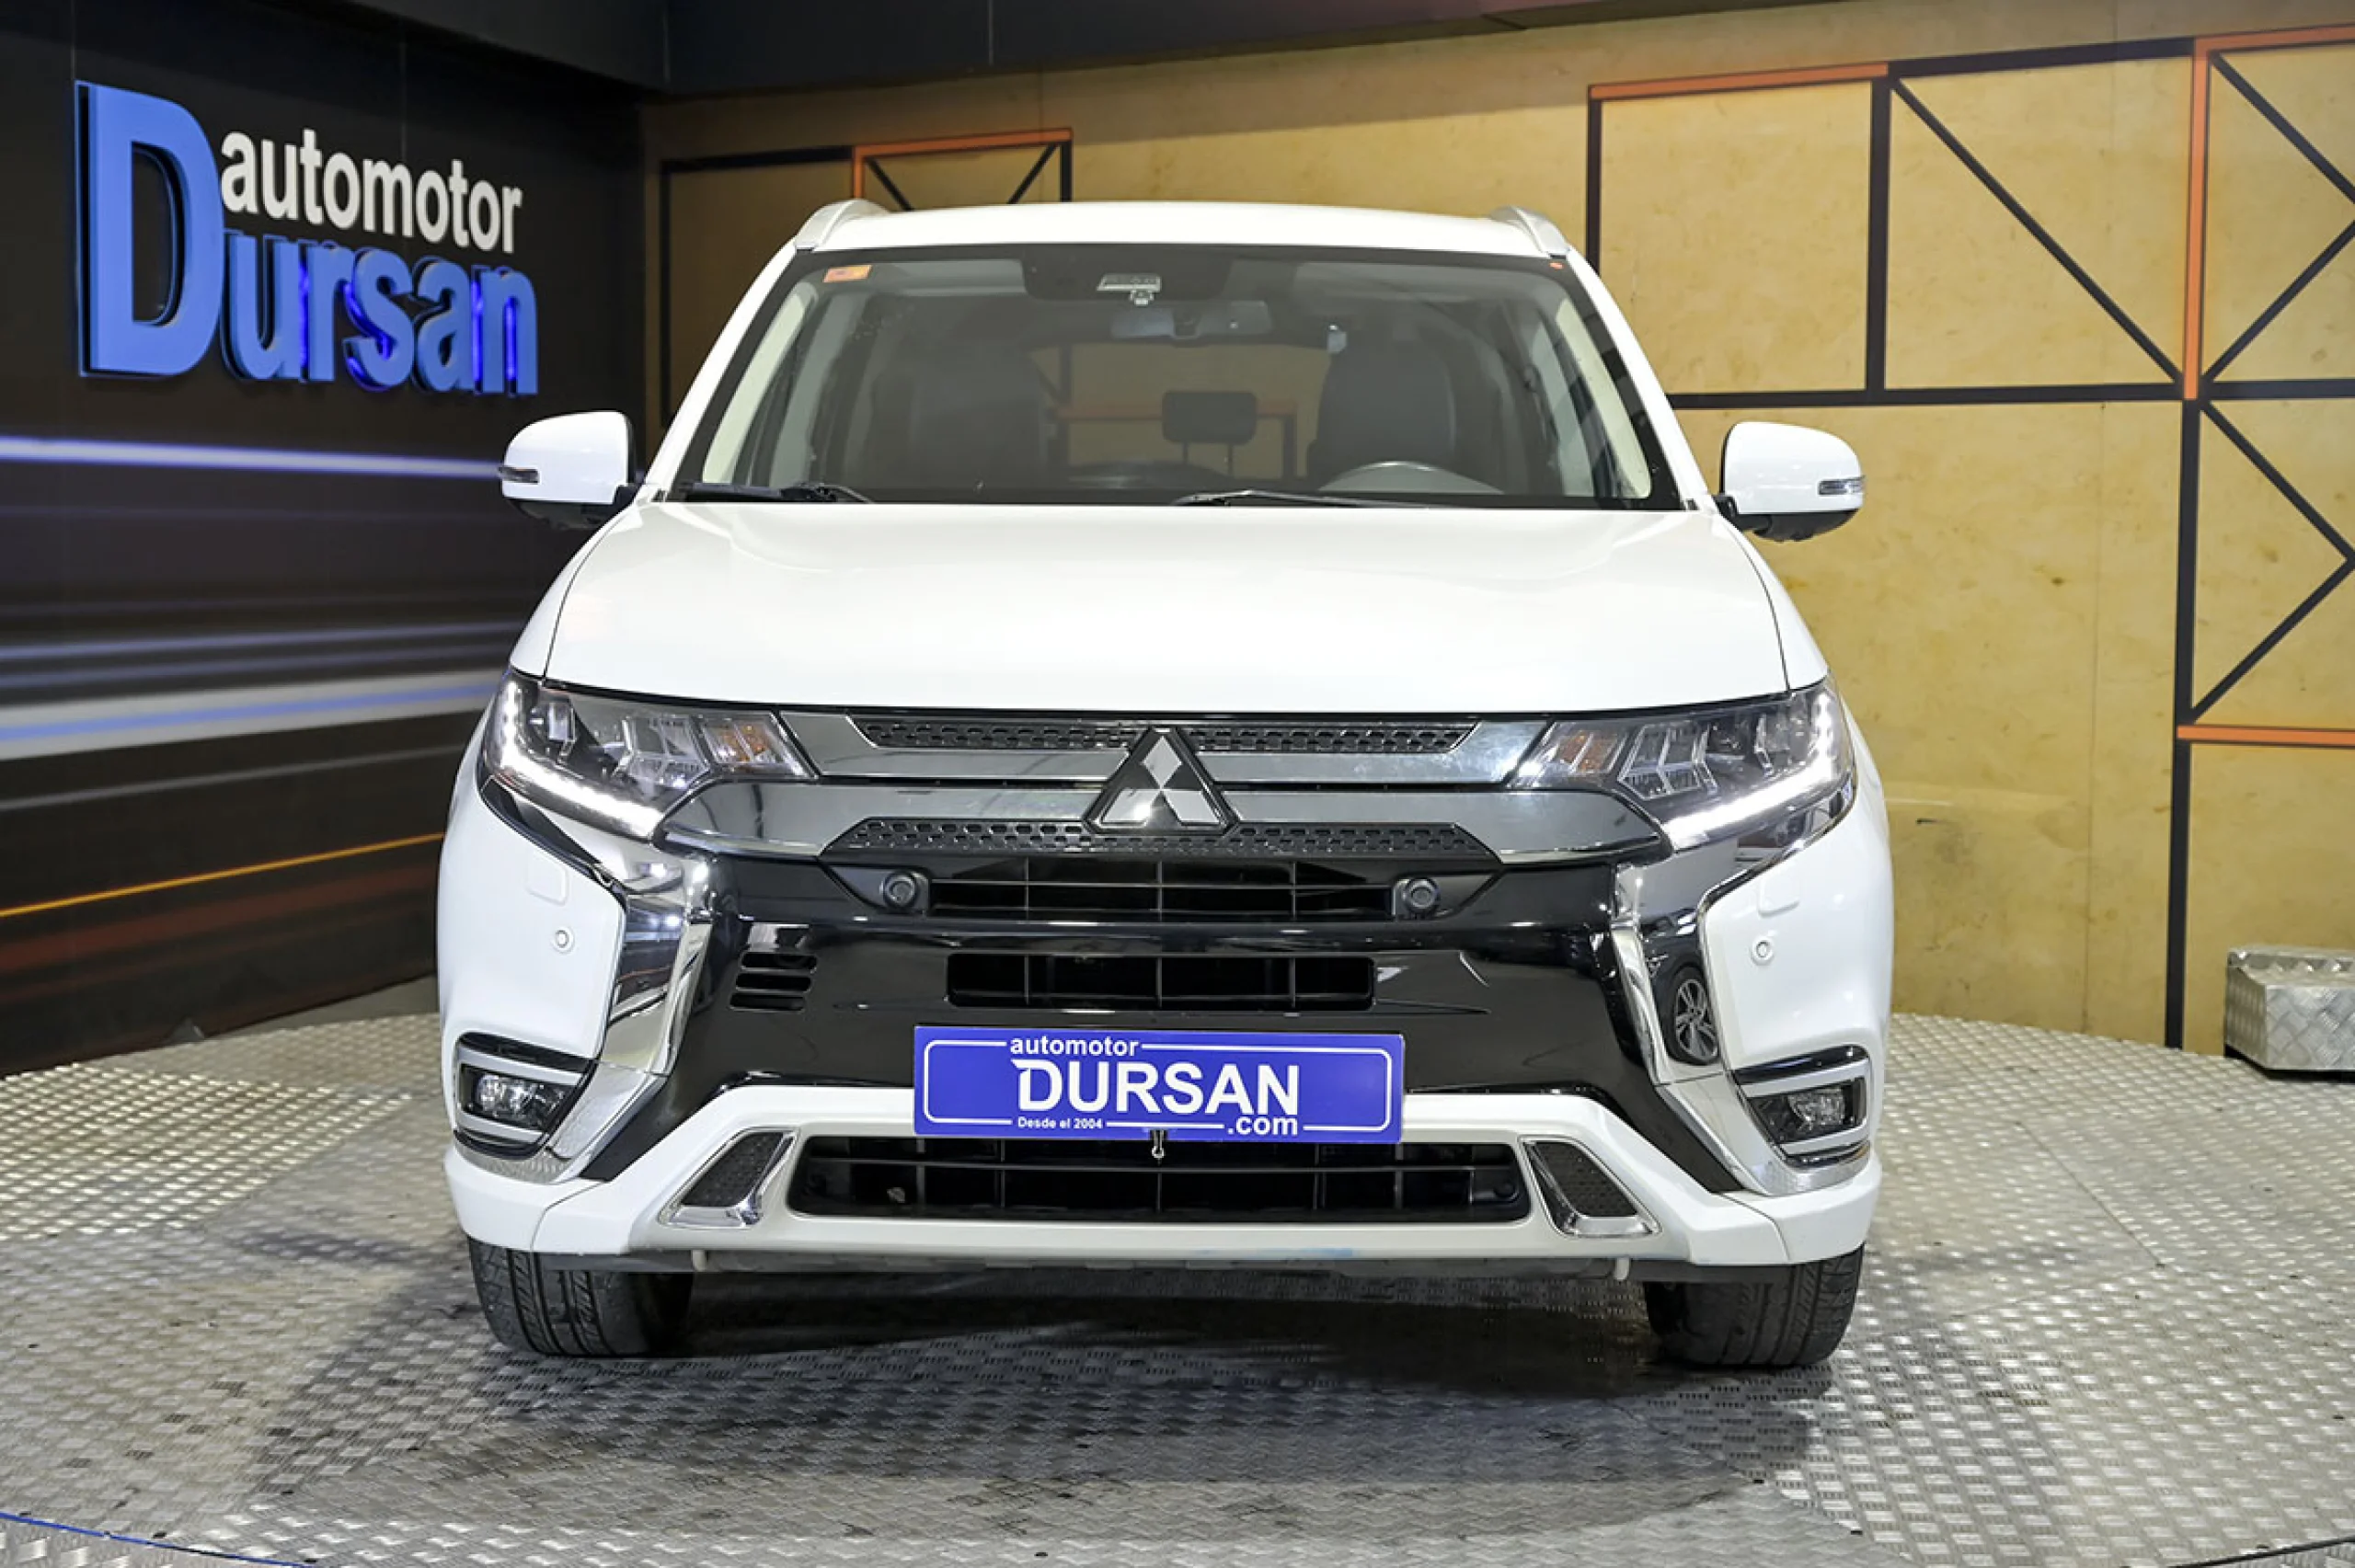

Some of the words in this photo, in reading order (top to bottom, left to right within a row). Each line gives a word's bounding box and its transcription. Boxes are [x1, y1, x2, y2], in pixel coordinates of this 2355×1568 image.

[221, 128, 523, 254] automotor
[75, 80, 538, 395] Dursan
[1010, 1036, 1140, 1057] automotor
[1011, 1059, 1300, 1116] DURSAN
[1017, 1116, 1057, 1128] Desde
[1059, 1117, 1071, 1129] el
[1073, 1117, 1103, 1129] 2004
[1227, 1116, 1298, 1136] .com
